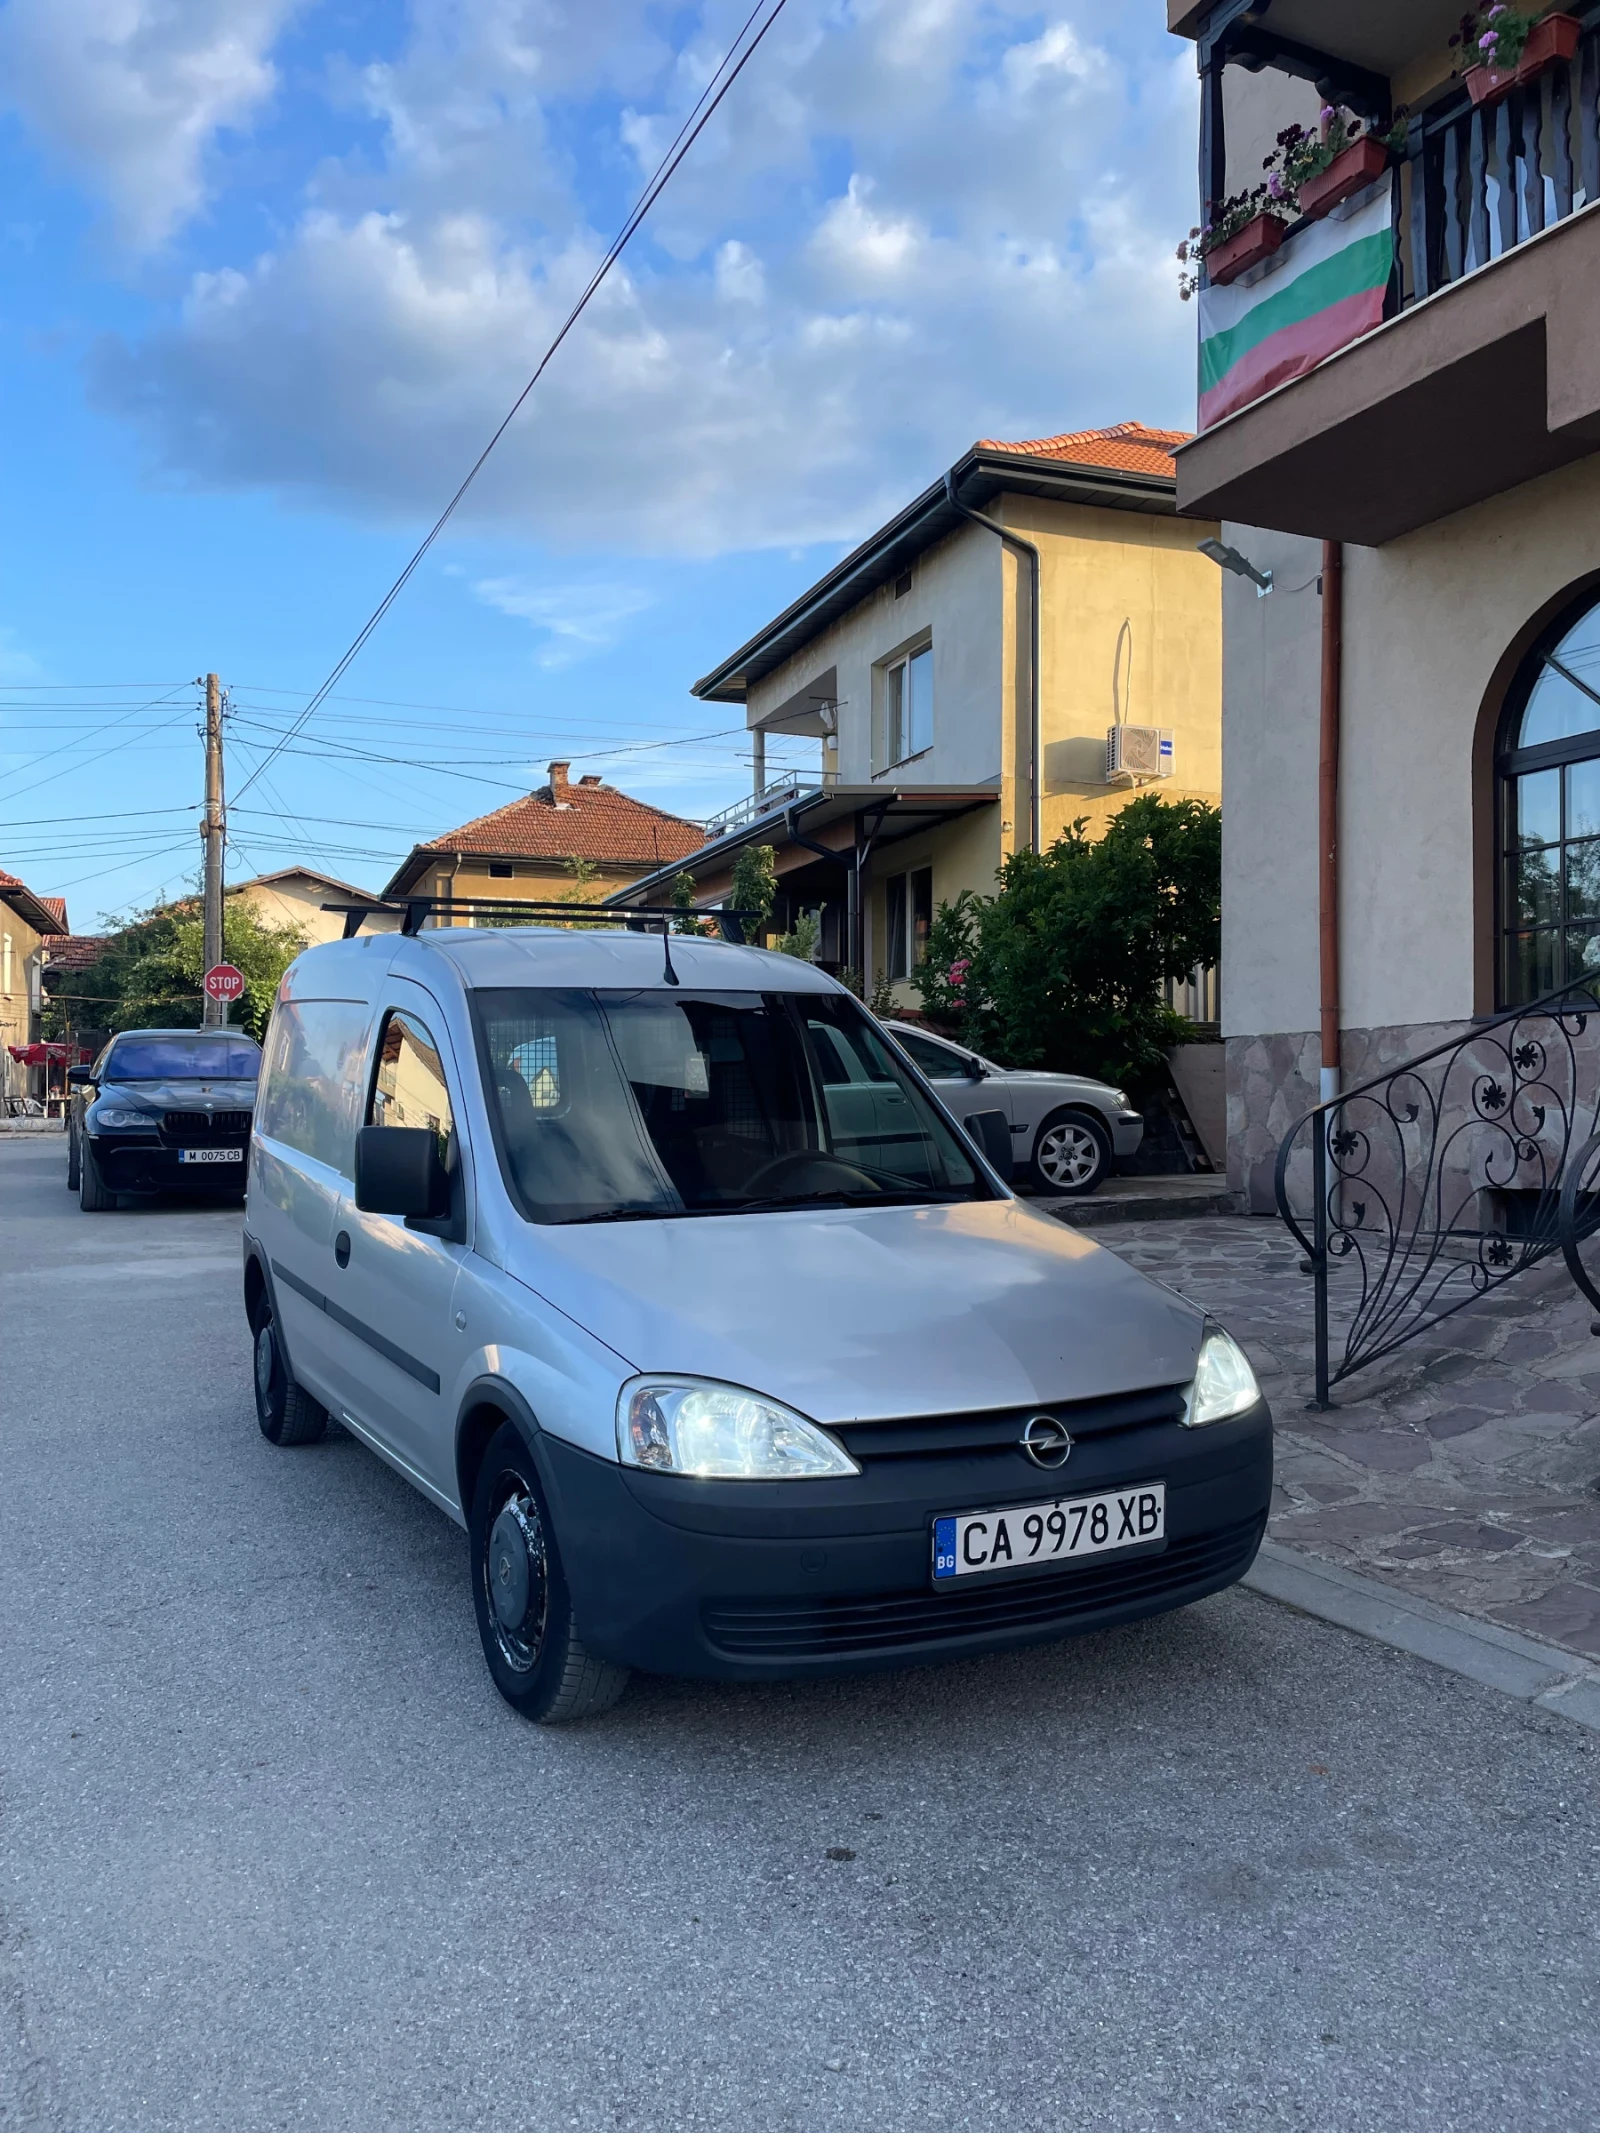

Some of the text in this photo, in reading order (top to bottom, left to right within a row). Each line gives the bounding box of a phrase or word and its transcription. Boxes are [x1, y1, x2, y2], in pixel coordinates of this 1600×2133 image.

[209, 976, 240, 989] STOP
[189, 1150, 240, 1161] M 0075 CB
[963, 1493, 1158, 1566] CA 9978 XB
[937, 1555, 954, 1569] BG
